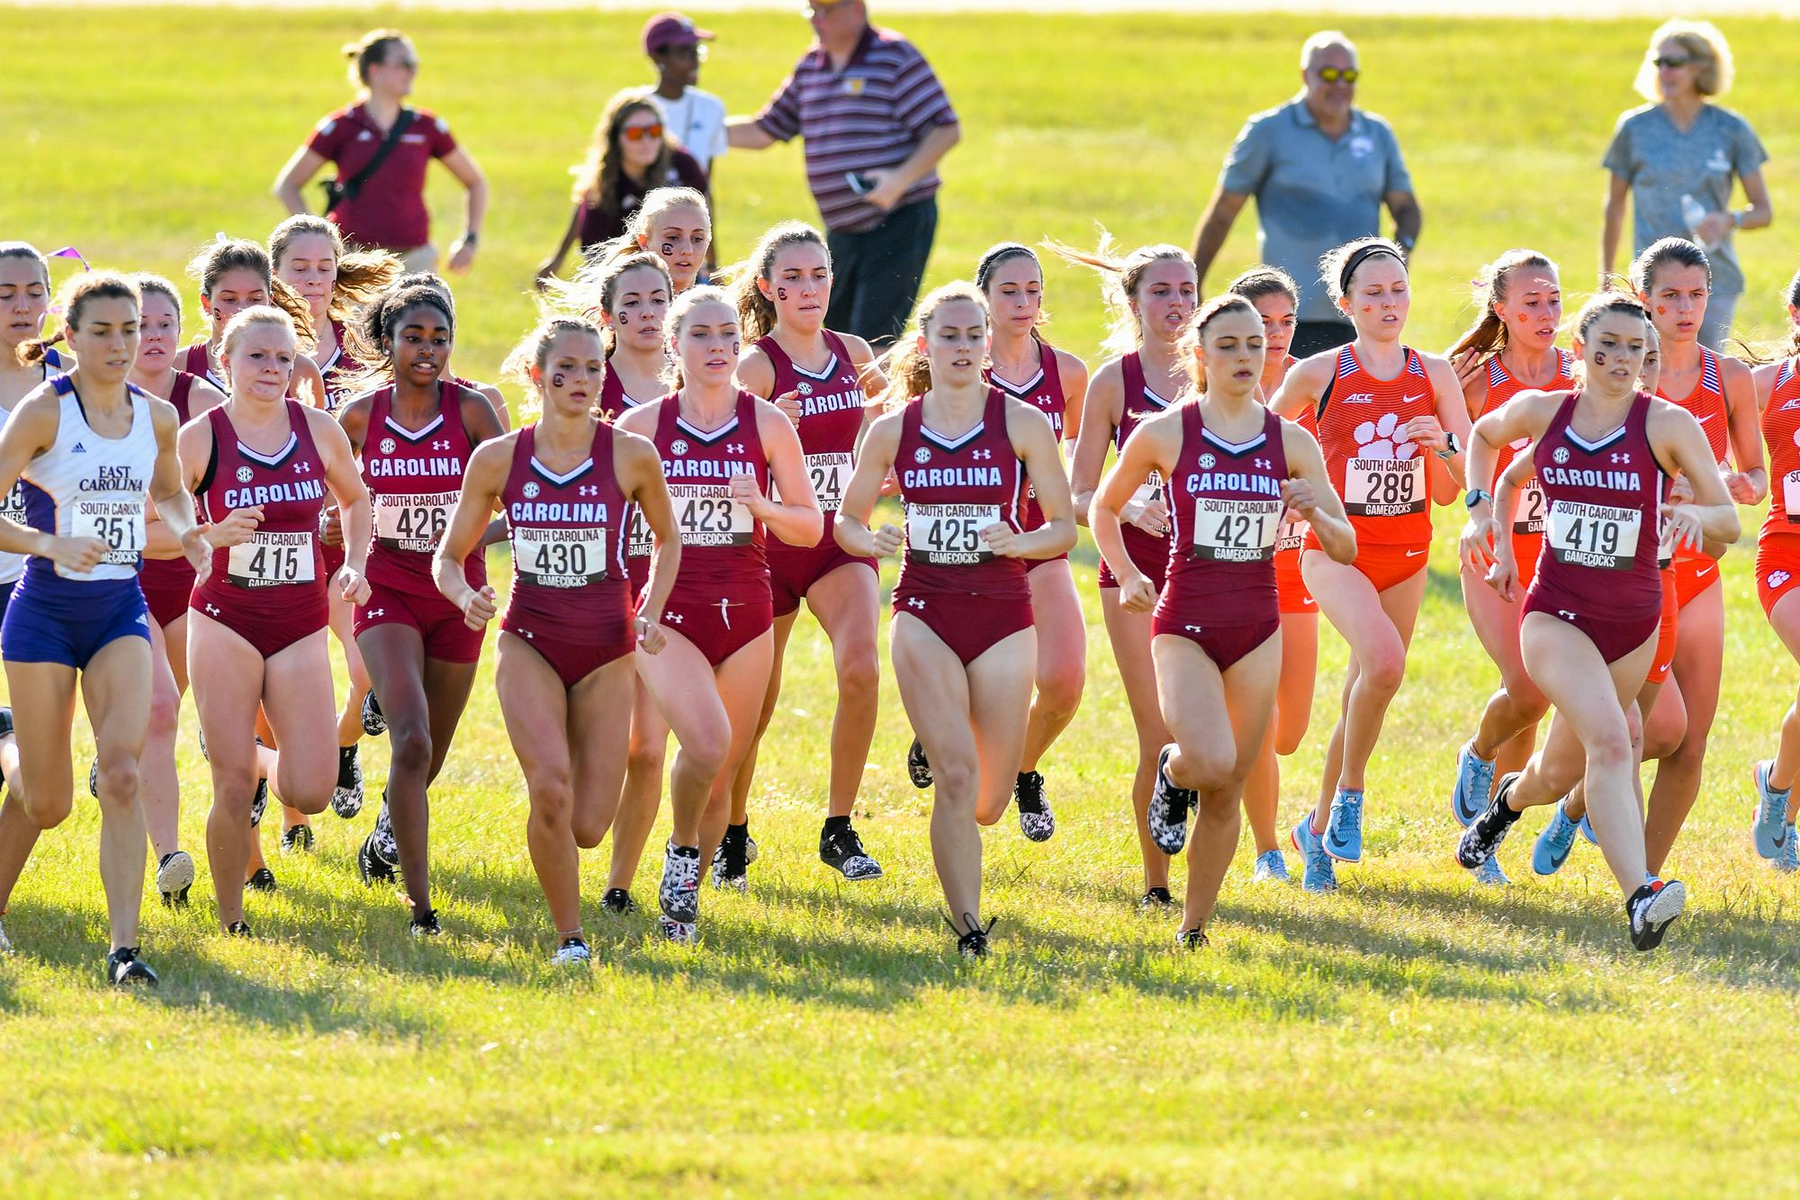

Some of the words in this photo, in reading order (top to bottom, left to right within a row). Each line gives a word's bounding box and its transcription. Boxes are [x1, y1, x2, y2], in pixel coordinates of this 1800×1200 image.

[1343, 393, 1374, 403] ACC
[381, 439, 396, 454] SEC
[671, 440, 688, 455] SEC
[810, 454, 848, 467] CAROLINA
[915, 447, 931, 463] SEC
[1198, 453, 1215, 469] SEC
[1553, 447, 1570, 464] SEC
[99, 466, 131, 479] EAST
[370, 457, 461, 476] CAROLINA
[661, 459, 756, 478] CAROLINA
[1354, 459, 1384, 471] SOUTH
[236, 466, 253, 483] SEC
[904, 467, 1003, 488] CAROLINA
[1543, 466, 1641, 491] CAROLINA
[79, 478, 143, 491] CAROLINA
[523, 482, 540, 498] SEC
[669, 485, 698, 498] SOUTH
[700, 486, 733, 498] CAROL
[1186, 472, 1281, 498] CAROLINA
[1366, 473, 1414, 504] 289
[225, 479, 323, 508] CAROLINA
[381, 495, 411, 507] SOUTH
[413, 492, 459, 507] CAROLINA
[80, 502, 110, 515] SOUTH
[512, 502, 607, 523] CAROLINA
[681, 499, 732, 531] 423
[915, 504, 943, 517] SOUTH
[945, 505, 993, 517] CAROLINA
[1204, 500, 1235, 513] SOUTH
[1237, 502, 1278, 514] CAROLINA
[1365, 504, 1411, 515] GAMECOCKS
[1557, 502, 1586, 517] SOUTH
[1588, 506, 1634, 522] CAROLINA
[396, 508, 447, 539] 426
[1215, 515, 1264, 547] 421
[94, 517, 135, 549] 351
[251, 533, 269, 545] UTH
[271, 533, 308, 546] CAROLINA
[521, 528, 549, 542] SOUTH
[552, 529, 599, 542] CAROLINA
[682, 533, 733, 545] GAMECOCKS
[928, 519, 979, 551] 425
[1565, 518, 1619, 554] 419
[535, 544, 586, 575] 430
[929, 552, 980, 564] GAMECOCKS
[1214, 547, 1262, 560] GAMECOCKS
[1564, 549, 1616, 568] GAMECOCKS
[249, 547, 297, 580] 415
[536, 575, 587, 588] GAMECOCKS
